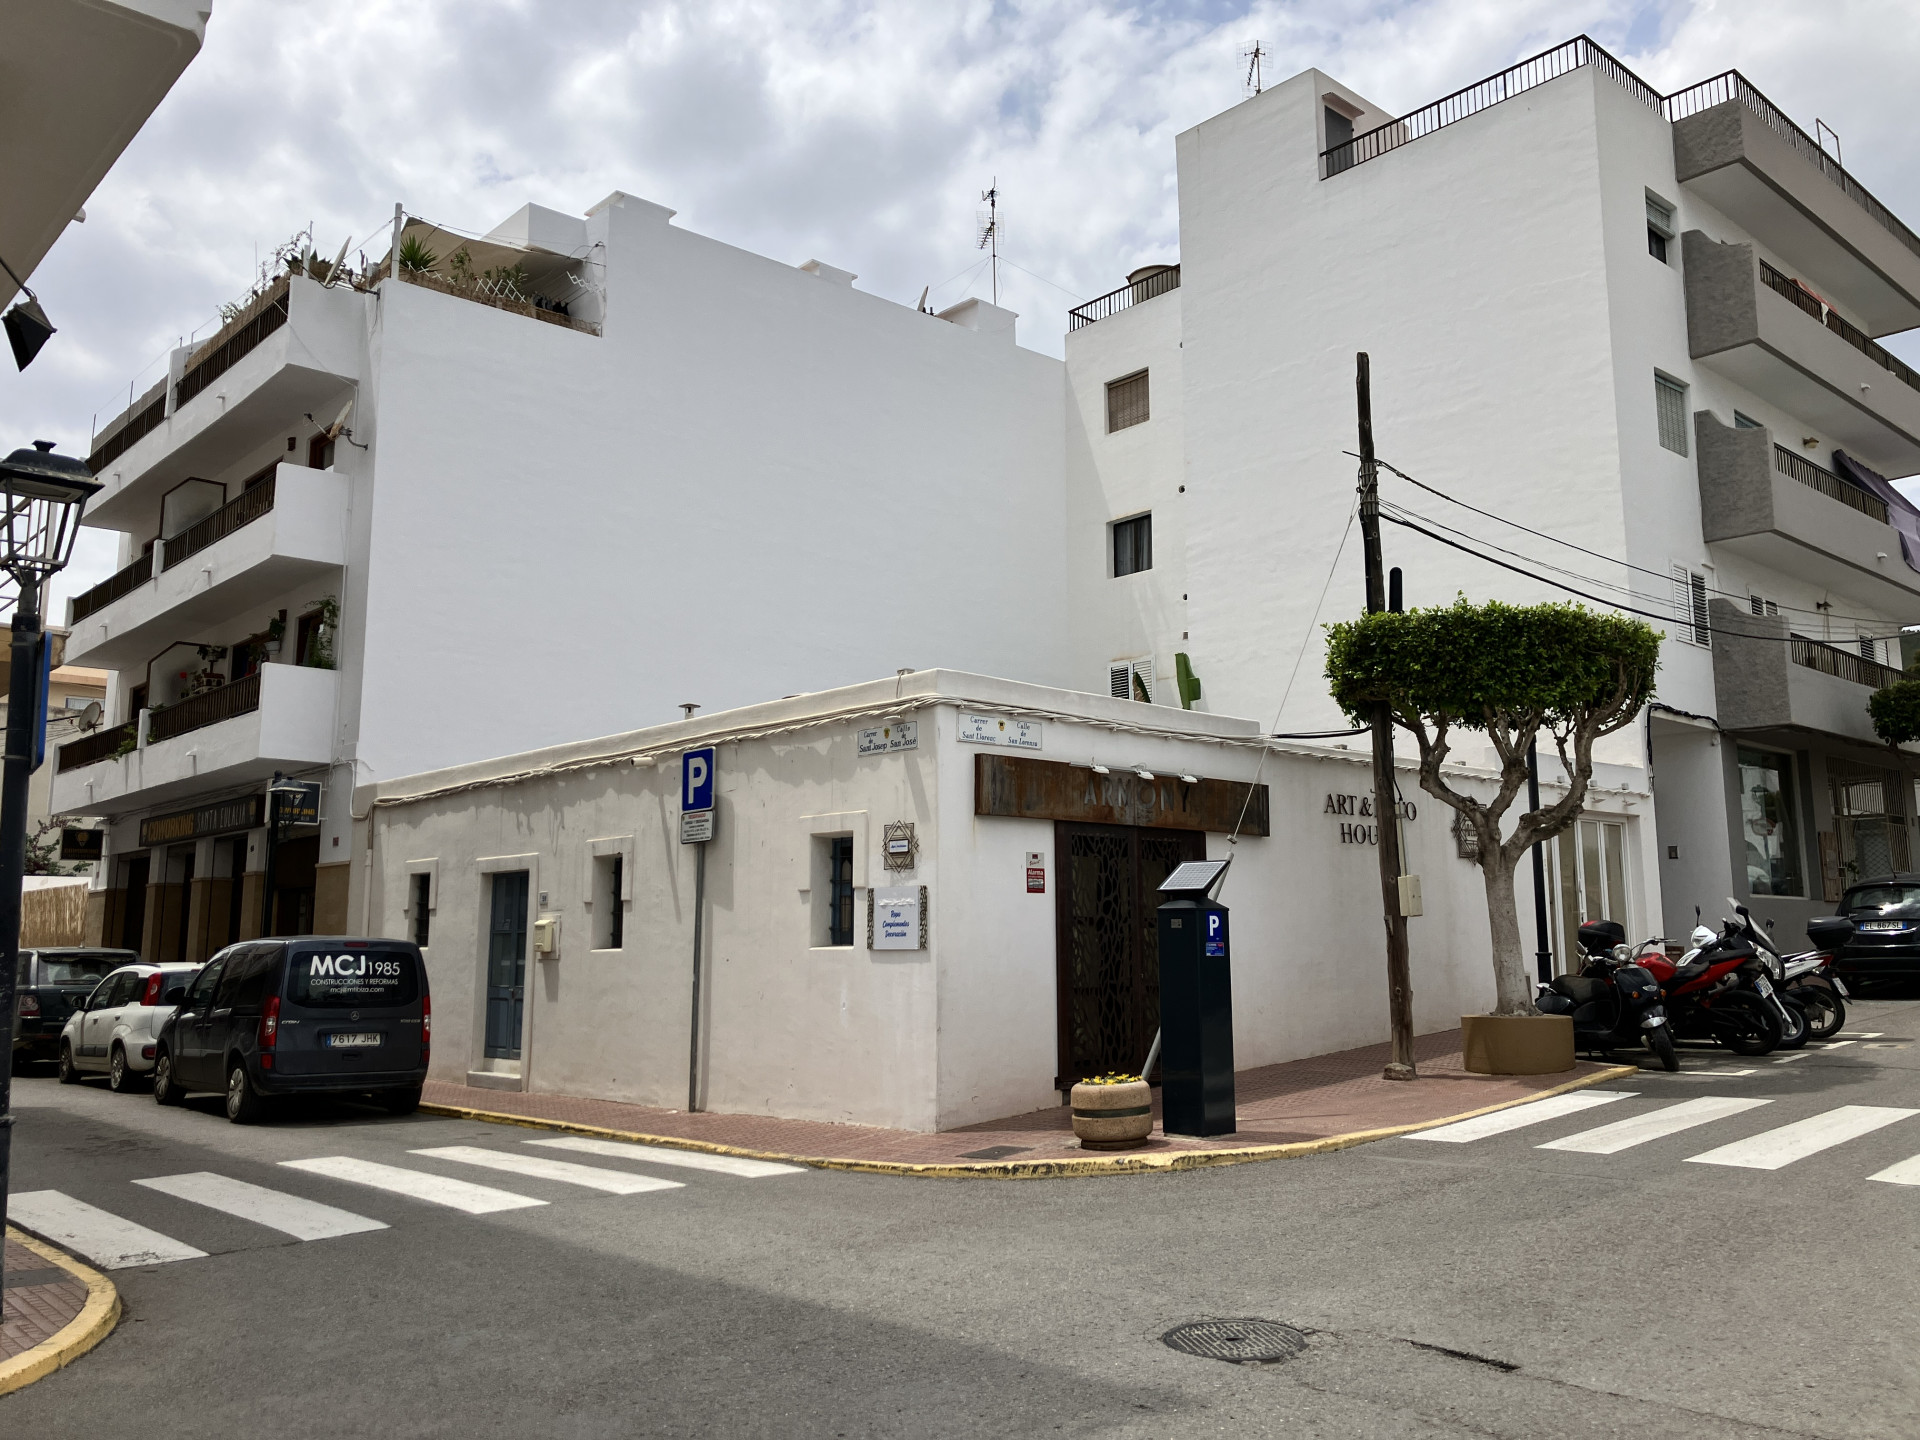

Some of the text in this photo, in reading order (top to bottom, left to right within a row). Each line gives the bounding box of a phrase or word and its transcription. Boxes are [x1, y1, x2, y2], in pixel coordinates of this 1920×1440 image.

[970, 716, 988, 724] Carrer
[1017, 722, 1030, 730] Calle
[872, 742, 887, 751] Josep
[890, 737, 917, 748] San José
[1008, 737, 1018, 745] San
[688, 756, 708, 805] P
[1084, 777, 1191, 812] ARMONY
[1324, 793, 1357, 816] ART
[1359, 797, 1373, 817] &
[148, 813, 195, 841] COWORKING
[1340, 823, 1379, 845] HOU
[1209, 915, 1220, 936] P
[310, 955, 401, 976] MCJ 1985
[332, 1033, 379, 1044] 7617 JHK
